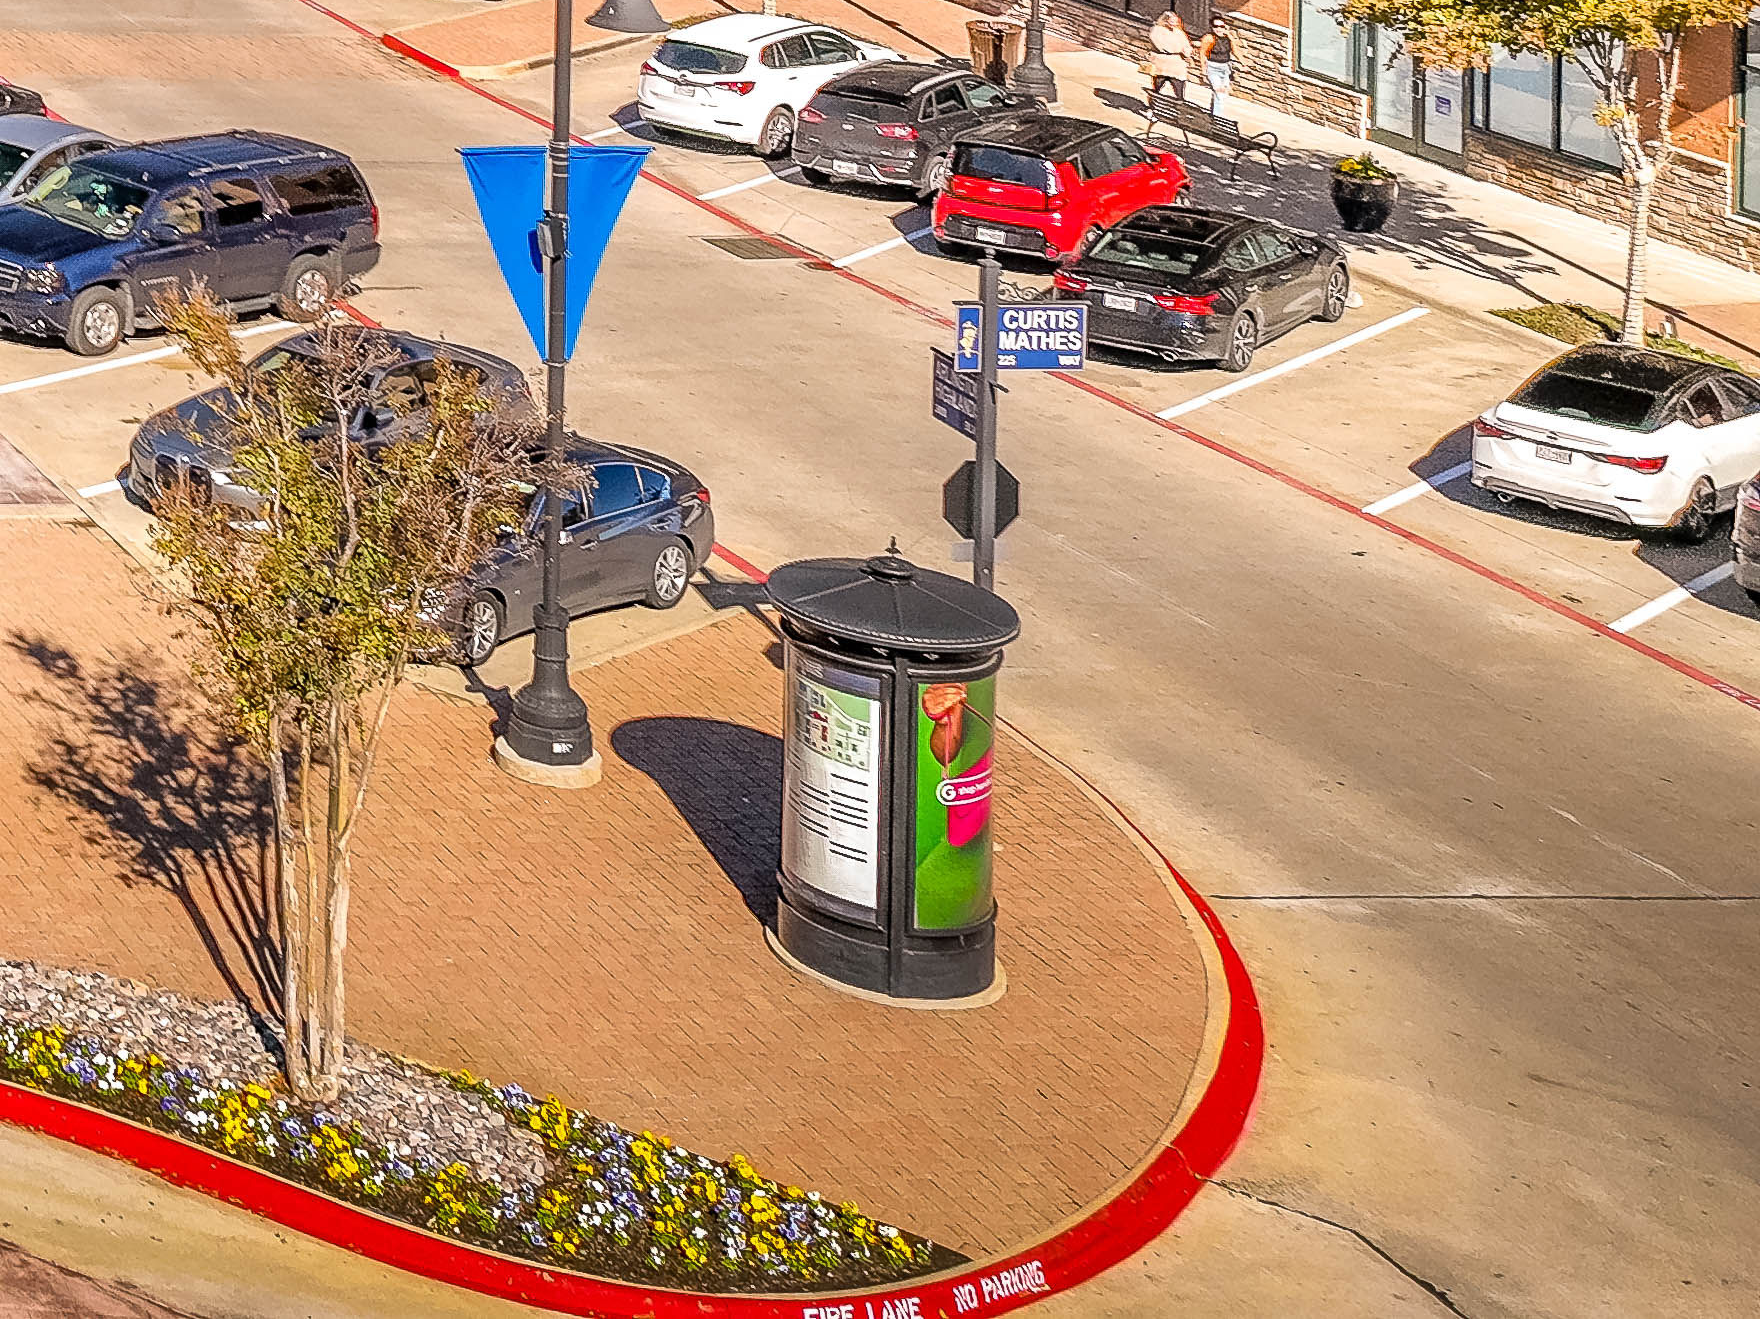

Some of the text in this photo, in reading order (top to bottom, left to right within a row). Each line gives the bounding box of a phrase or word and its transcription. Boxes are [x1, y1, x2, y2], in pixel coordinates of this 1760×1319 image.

[1003, 309, 1080, 330] CURTIS
[998, 331, 1082, 351] MATHES
[951, 1259, 1046, 1314] NO PARKING
